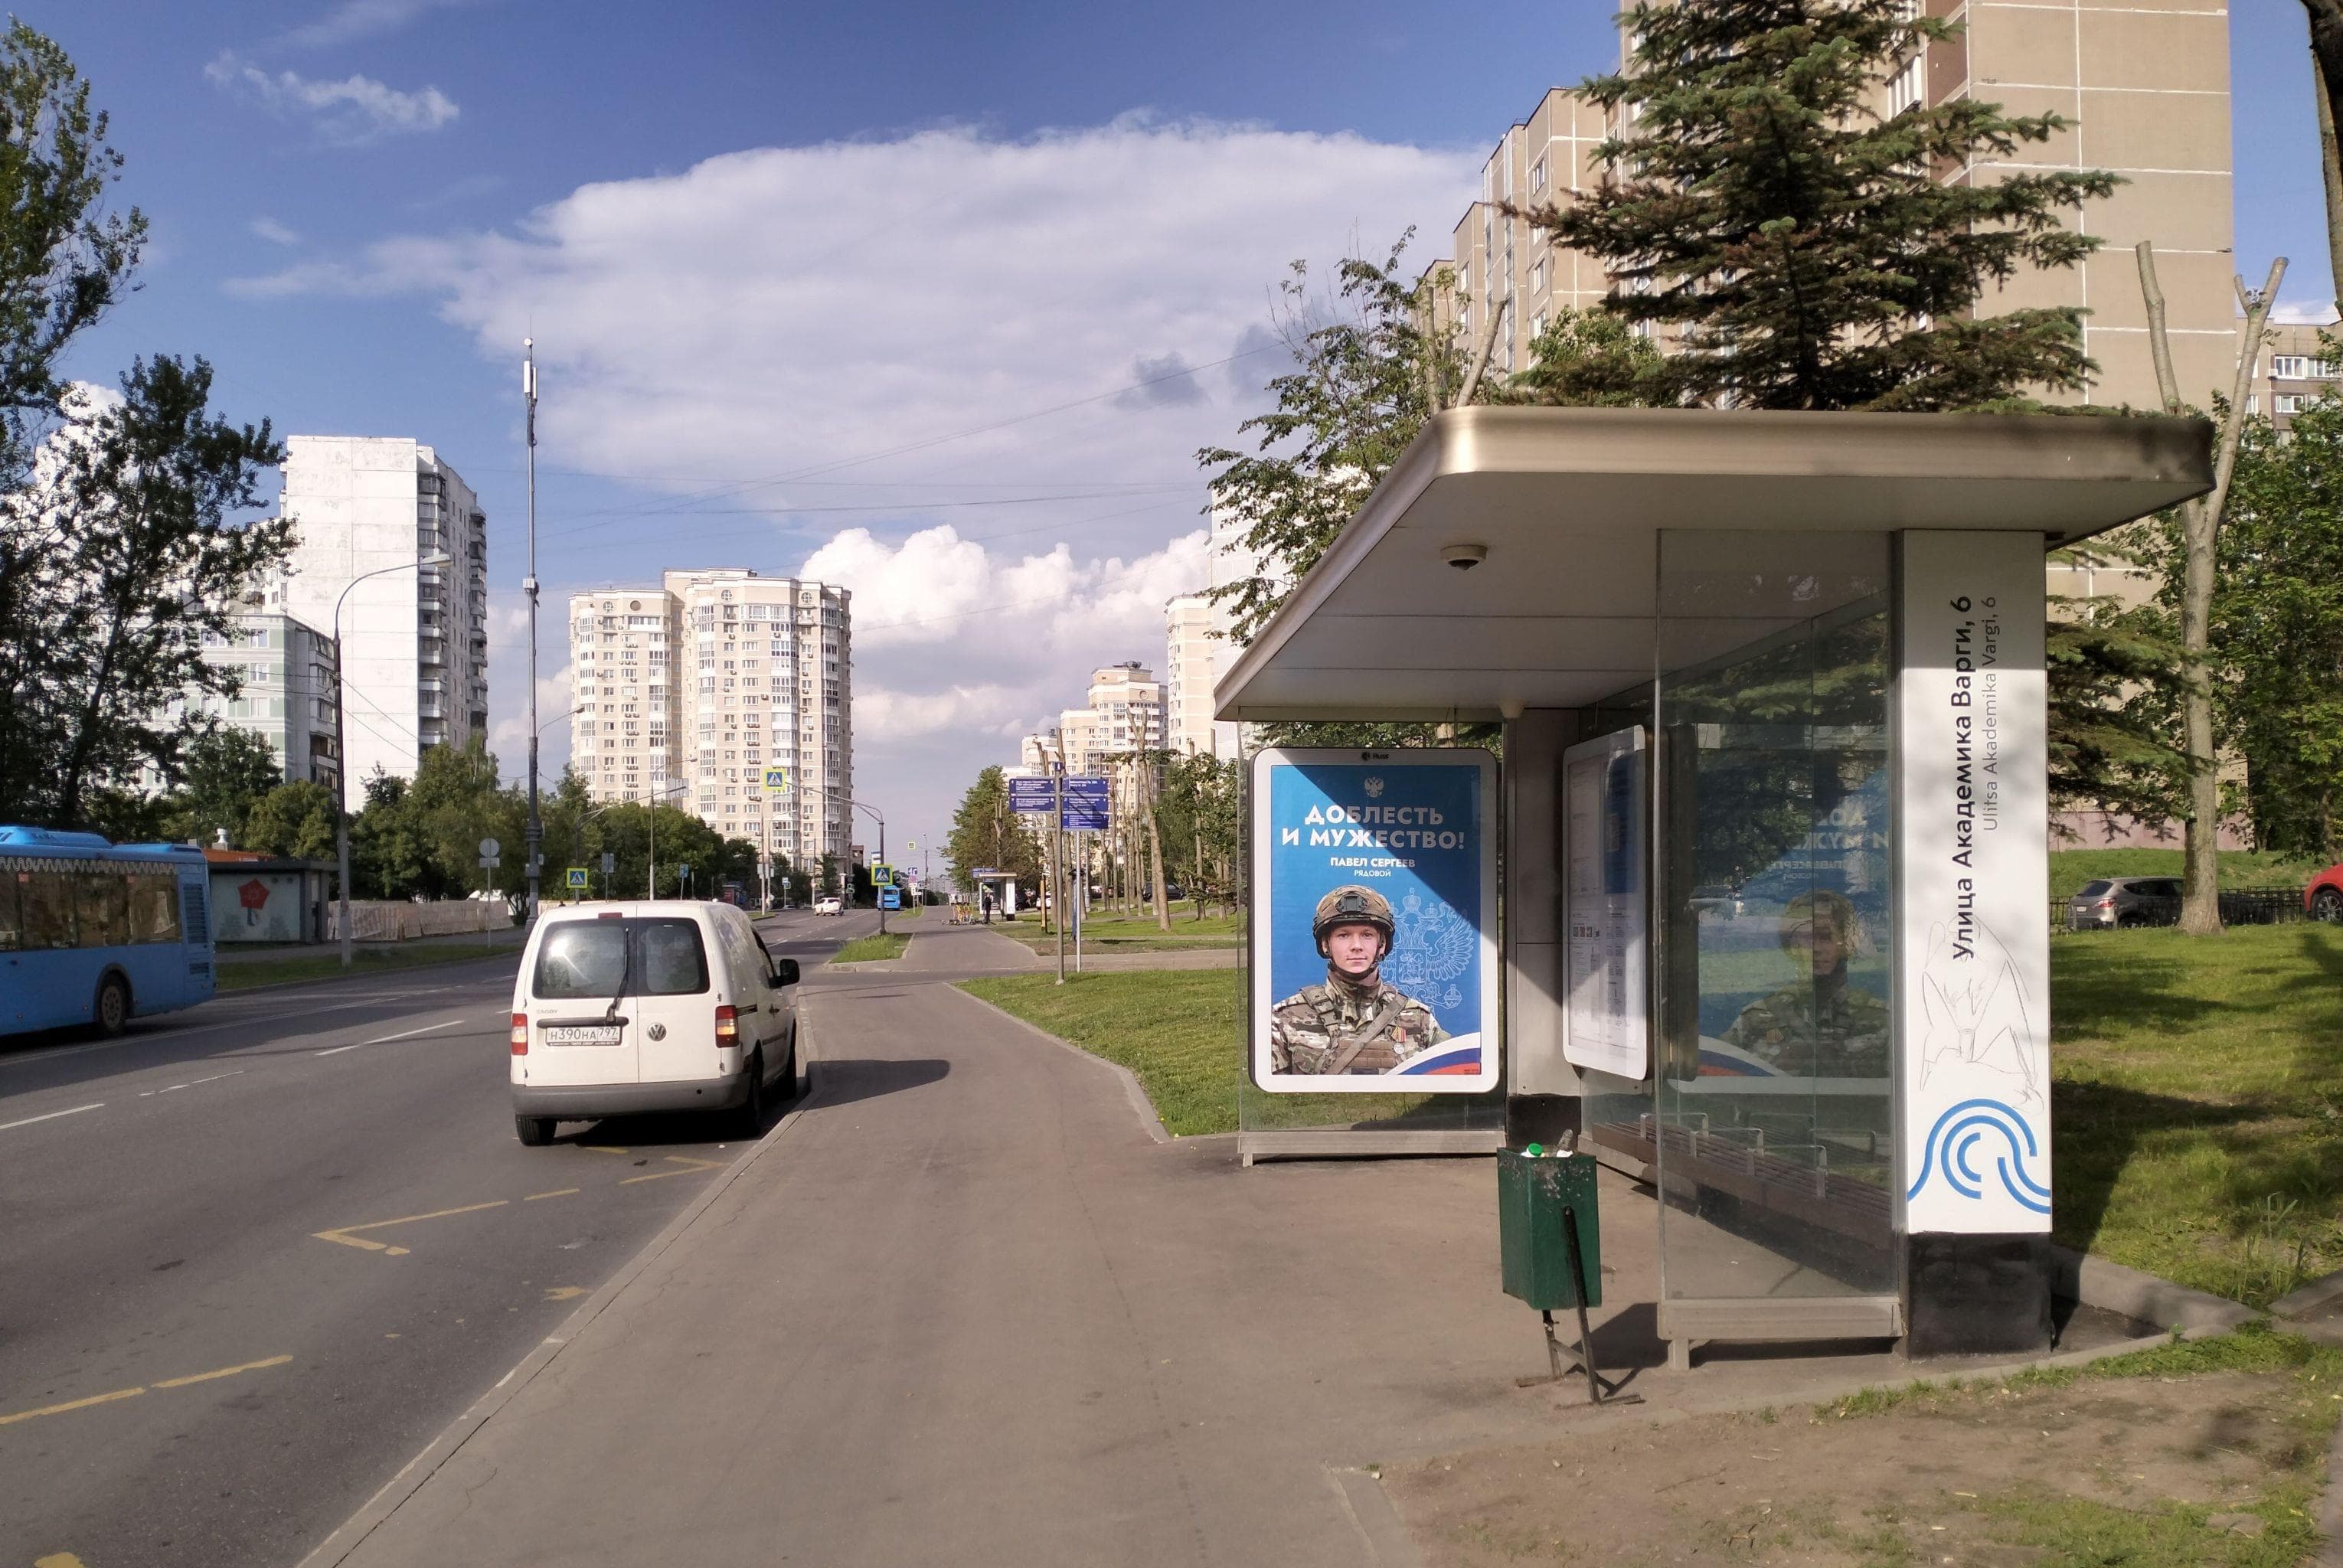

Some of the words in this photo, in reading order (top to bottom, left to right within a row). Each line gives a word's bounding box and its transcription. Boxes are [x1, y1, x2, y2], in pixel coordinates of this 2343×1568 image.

[1949, 596, 1972, 612] 6
[1981, 596, 1996, 608] 6
[1981, 614, 2001, 667] Vargi,
[1950, 621, 1976, 707] Варги,
[1981, 673, 1998, 775] Akademika
[1952, 716, 1975, 869] Академика
[1304, 804, 1443, 825] ДОБЛЕСТЬ
[1982, 781, 1998, 831] Ulitsa
[1282, 828, 1299, 846] И
[1309, 828, 1465, 850] МУЖЕСТВО!
[1330, 857, 1368, 867] ПАВЕЛ
[1371, 858, 1416, 868] СЕРГЕЕВ
[1354, 869, 1391, 877] РЯДОВОЙ
[1953, 878, 1976, 960] Улица
[599, 1027, 616, 1036] 797
